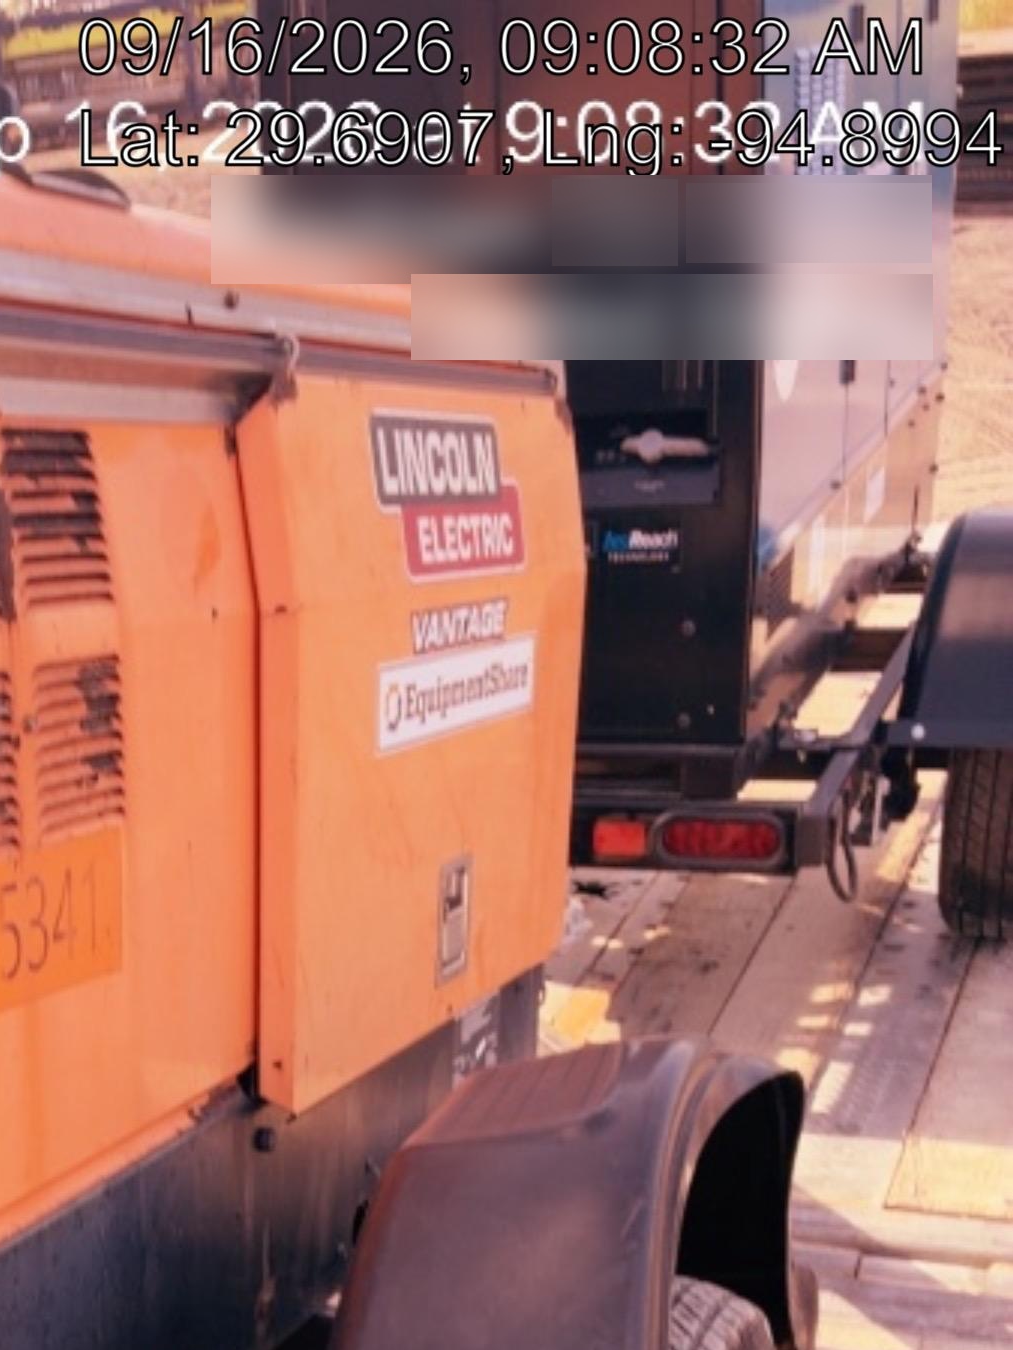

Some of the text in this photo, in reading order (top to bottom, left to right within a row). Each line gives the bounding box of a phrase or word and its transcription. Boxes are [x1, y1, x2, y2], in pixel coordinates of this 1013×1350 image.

[375, 424, 498, 497] LINCOLN
[416, 513, 515, 566] ELECTRIC
[410, 599, 509, 654] VANTAGE
[406, 662, 528, 724] EquipmentShare
